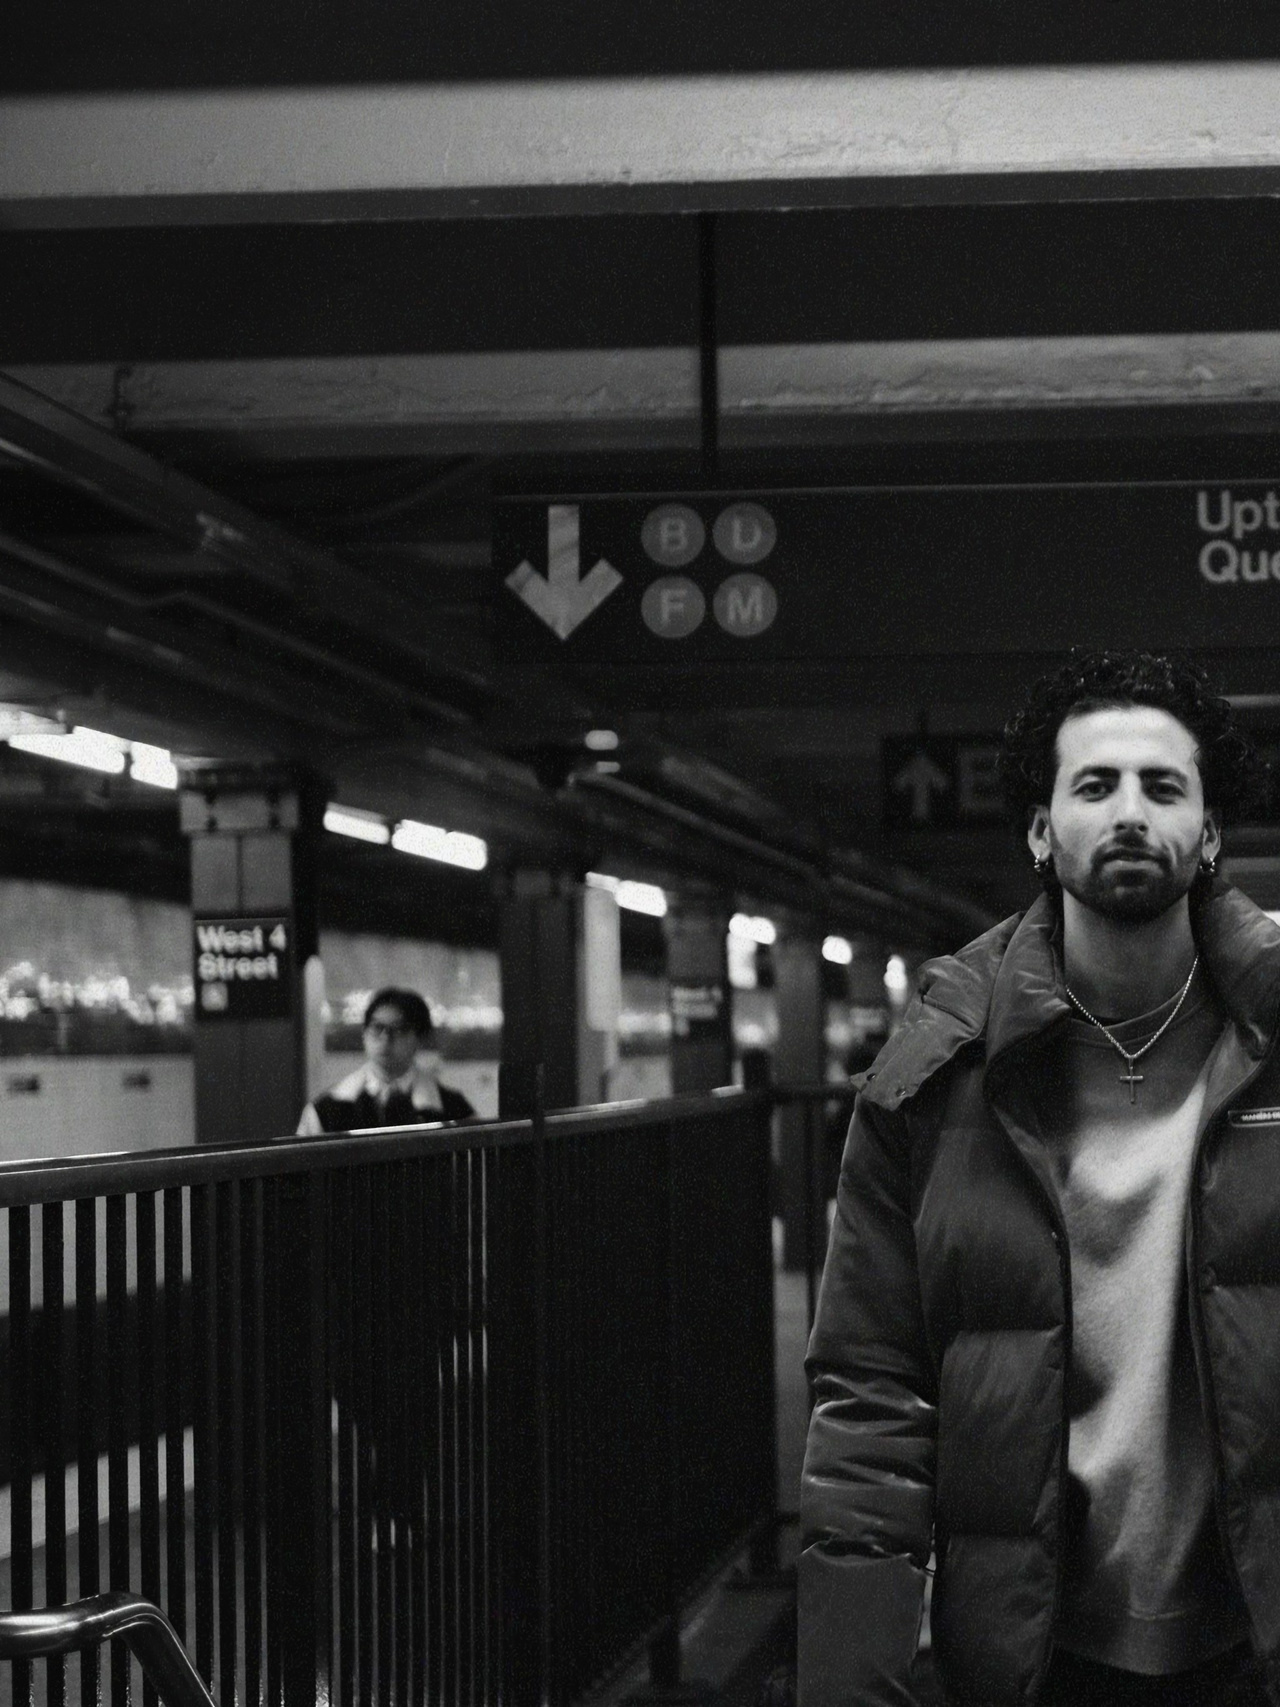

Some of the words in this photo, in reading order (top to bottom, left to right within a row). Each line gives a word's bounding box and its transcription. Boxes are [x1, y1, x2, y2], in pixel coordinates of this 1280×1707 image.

[659, 519, 688, 552] B
[732, 517, 764, 550] D
[661, 588, 689, 626] F
[726, 586, 764, 624] M
[196, 925, 264, 954] West
[268, 923, 287, 951] 4
[198, 952, 279, 982] Street
